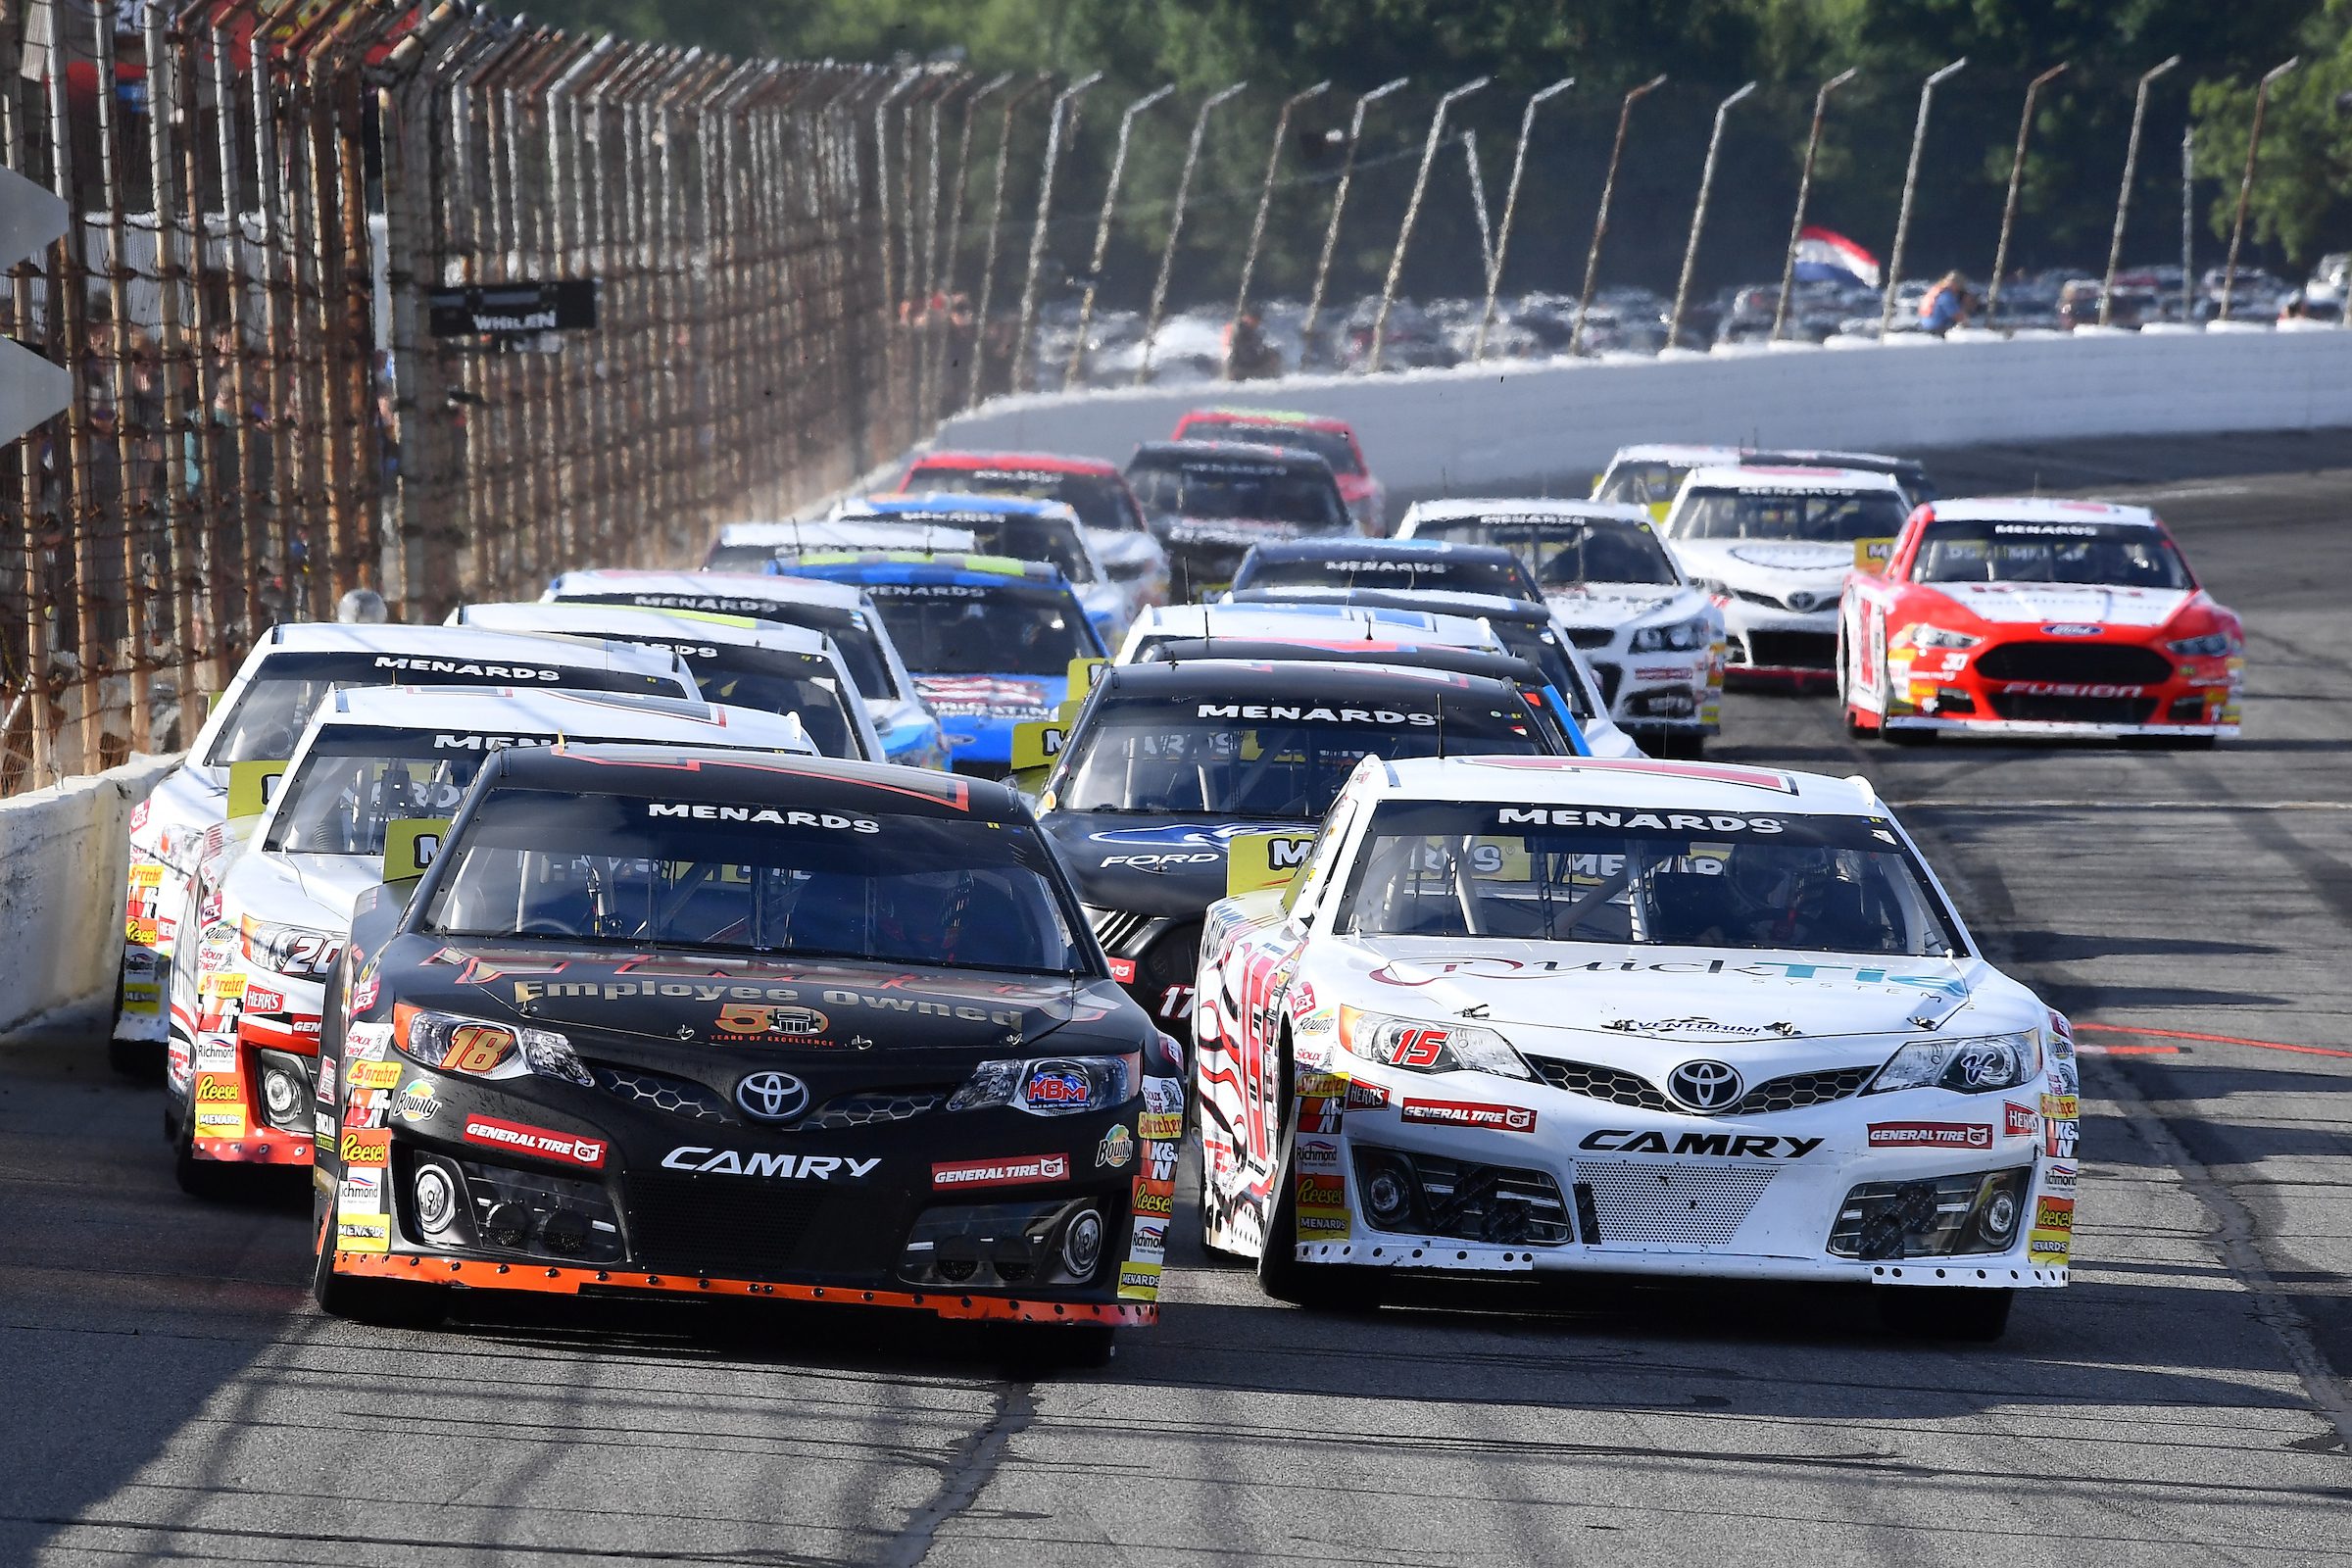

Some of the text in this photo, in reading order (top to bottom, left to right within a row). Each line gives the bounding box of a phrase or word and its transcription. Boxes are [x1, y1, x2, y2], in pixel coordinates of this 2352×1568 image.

[634, 595, 778, 613] MENARDS
[372, 656, 562, 682] MENARDS
[2002, 681, 2144, 699] FUSION
[1197, 704, 1441, 727] MENARDS
[648, 802, 881, 835] MENARDS
[1497, 808, 1787, 835] MENARDS
[1100, 852, 1220, 869] FORD
[247, 989, 281, 1011] HERR'S
[514, 980, 1023, 1031] Employee Owned
[198, 1045, 235, 1058] Richmond
[440, 1026, 515, 1072] 18
[767, 1036, 835, 1047] EXCELLENCE
[1390, 1027, 1449, 1067] 15
[350, 1062, 399, 1085] Sprecher
[1027, 1078, 1088, 1102] KBM
[1349, 1085, 1385, 1106] HERR'S
[393, 1094, 442, 1120] Bounty
[1403, 1104, 1470, 1122] GENERAL
[1471, 1108, 1505, 1124] TIRE
[466, 1122, 536, 1149] GENERAL
[537, 1137, 574, 1155] TIRE
[1577, 1129, 1826, 1158] CAMRY
[1870, 1129, 1935, 1143] GENERAL
[1935, 1129, 1966, 1143] TIRE
[341, 1134, 386, 1163] Reese's
[1096, 1137, 1134, 1167] Bounty
[1297, 1146, 1337, 1162] Richmond
[661, 1146, 883, 1181] CAMRY
[934, 1167, 1005, 1184] GENERAL
[1005, 1163, 1040, 1178] TIRE
[338, 1224, 386, 1239] MENARDS
[1299, 1217, 1347, 1231] MENARDS
[1121, 1274, 1160, 1289] MENARDS
